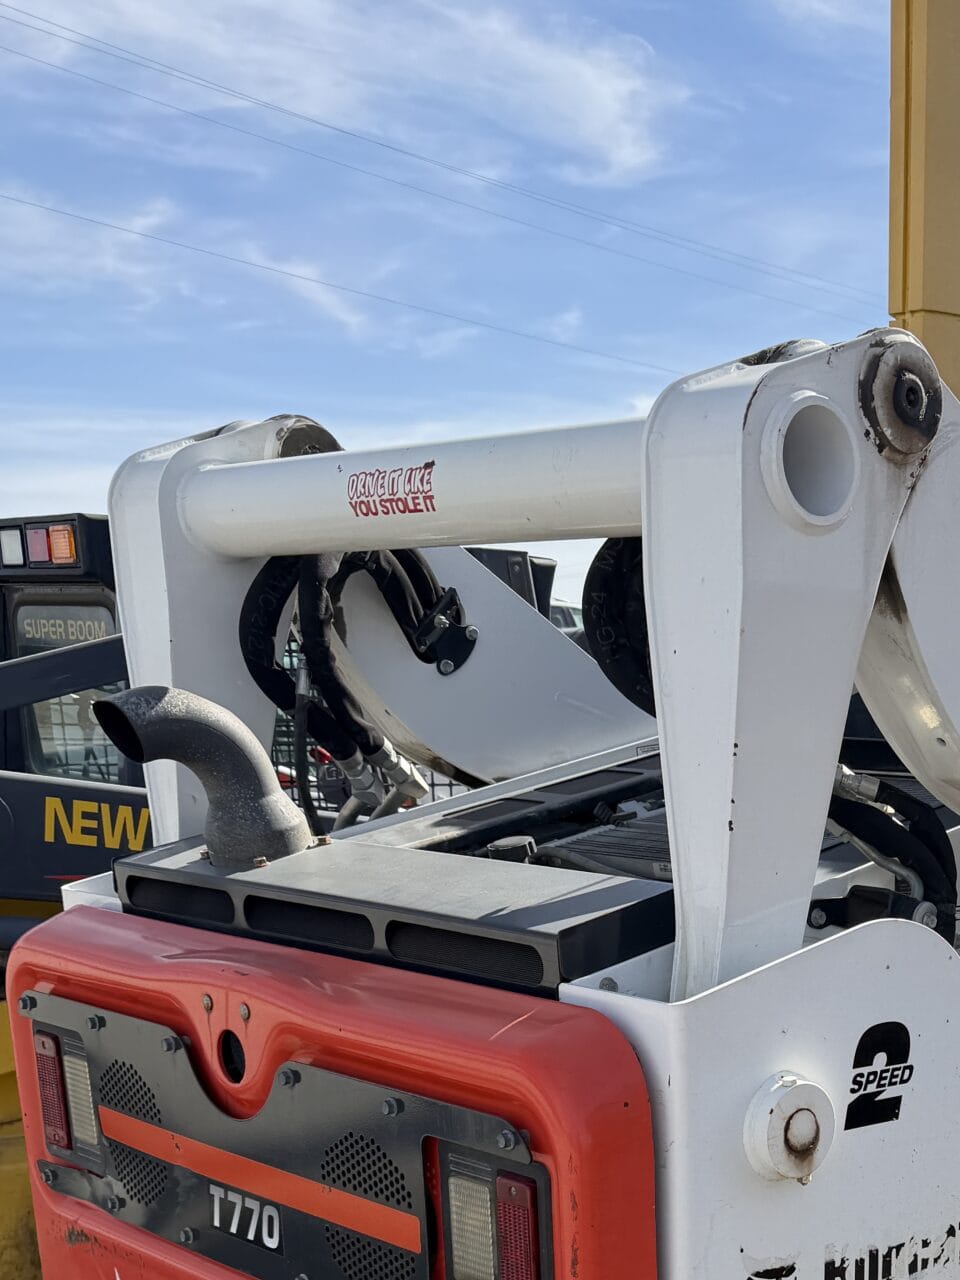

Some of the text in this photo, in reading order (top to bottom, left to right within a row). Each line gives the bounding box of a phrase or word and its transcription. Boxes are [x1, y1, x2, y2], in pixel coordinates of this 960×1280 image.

[347, 464, 434, 500] DRIVE IT LIKE
[349, 494, 437, 517] YOU STOLE IT
[23, 618, 107, 641] SUPER BOOM
[44, 796, 149, 851] NEW
[844, 1021, 911, 1131] 2
[849, 1064, 915, 1095] SPEED
[208, 1183, 280, 1250] T770
